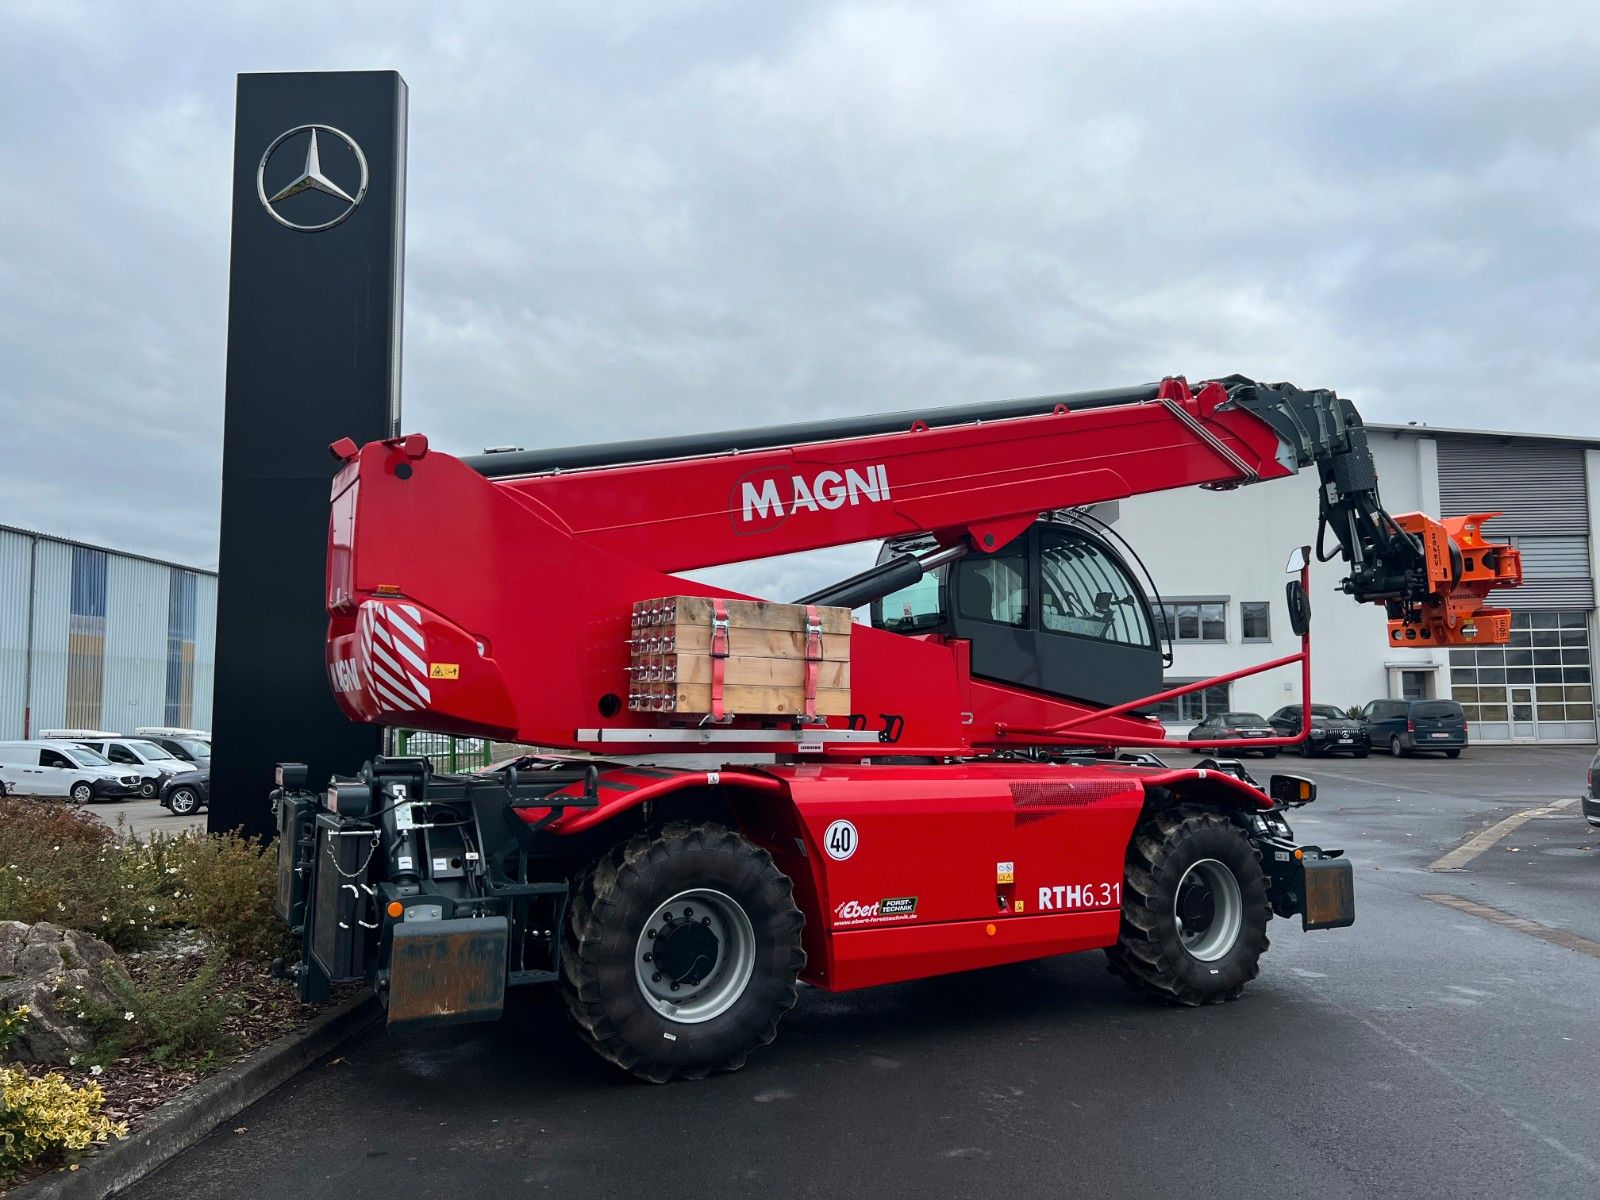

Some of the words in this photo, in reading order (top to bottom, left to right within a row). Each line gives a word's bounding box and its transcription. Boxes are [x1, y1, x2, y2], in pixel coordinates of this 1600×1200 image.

[742, 464, 890, 522] MAGNI
[830, 827, 850, 852] 40
[886, 899, 912, 907] FORST-
[1038, 882, 1120, 910] RTH6.31
[843, 900, 880, 918] Ebert
[882, 905, 913, 913] TECHNIK
